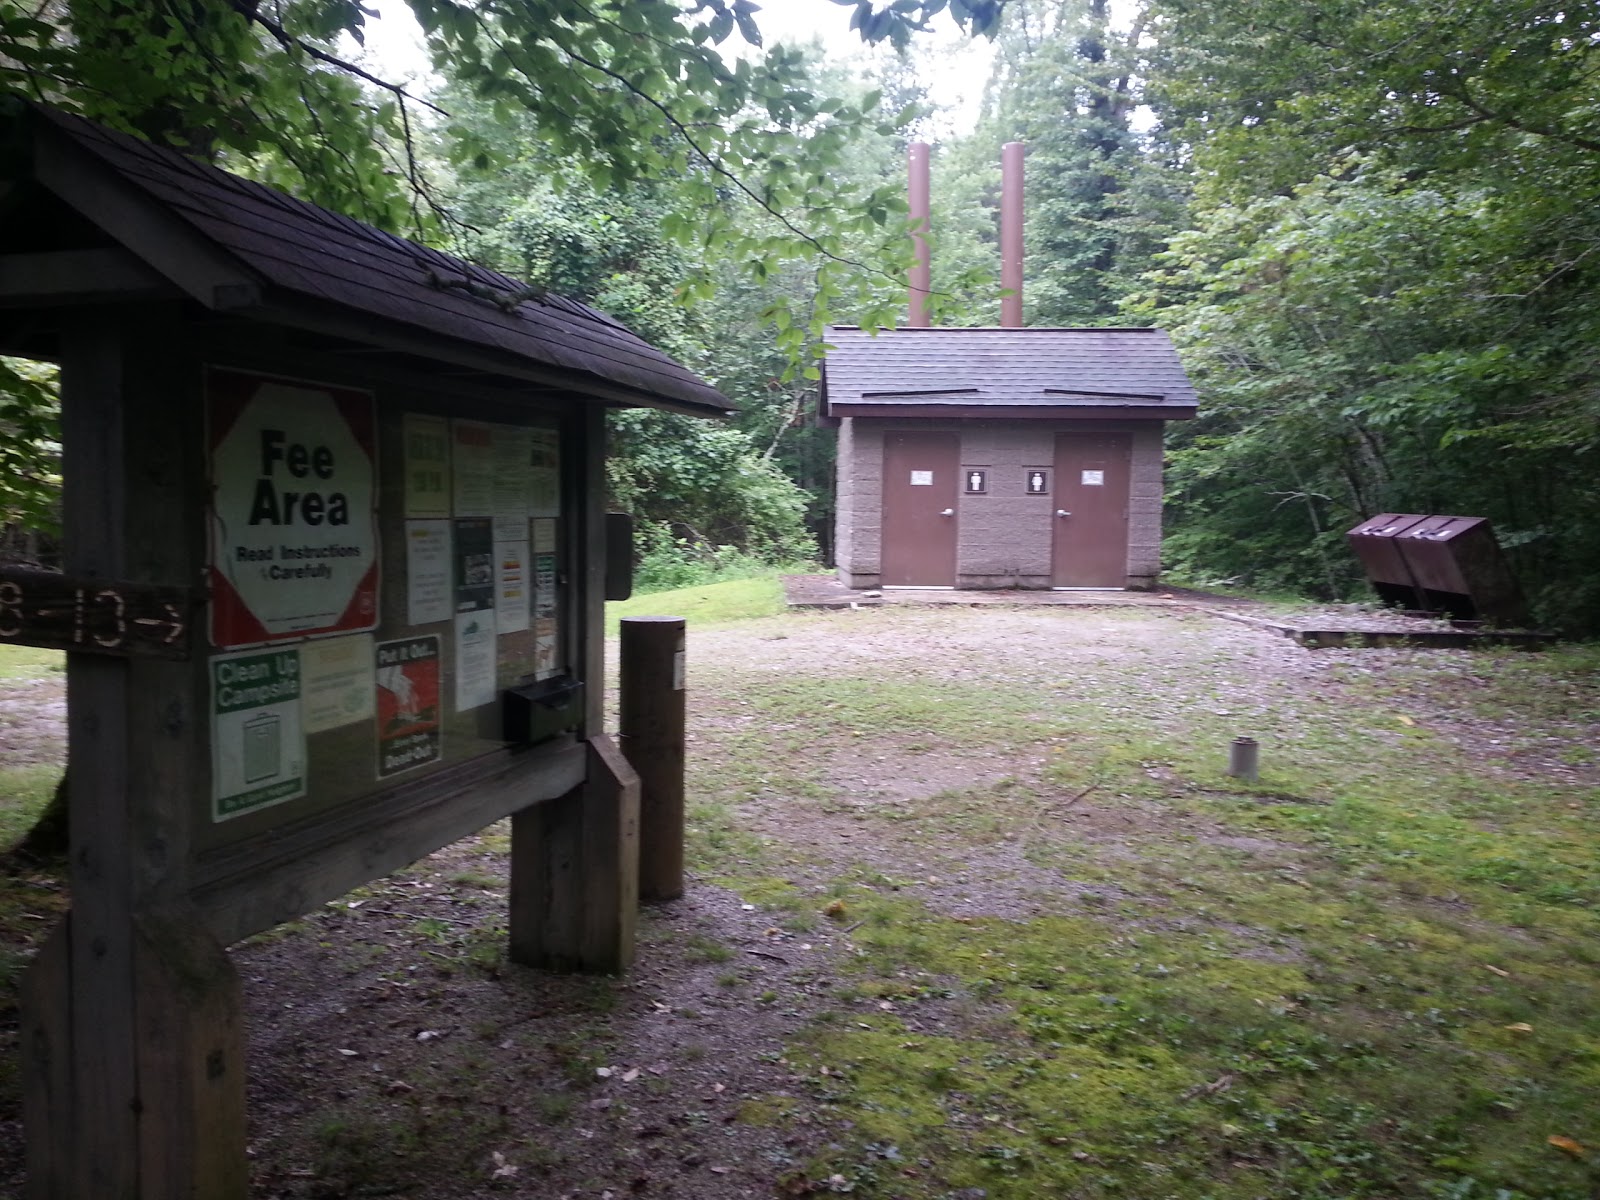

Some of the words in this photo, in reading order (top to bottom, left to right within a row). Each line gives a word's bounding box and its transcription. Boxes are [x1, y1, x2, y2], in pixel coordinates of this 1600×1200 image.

[259, 429, 335, 480] Fee
[248, 478, 350, 526] Area
[236, 546, 273, 562] Read
[280, 544, 361, 560] Instructions
[269, 562, 332, 581] Carefully
[218, 662, 271, 685] Clean
[276, 654, 298, 677] Up
[218, 679, 299, 706] Campsite
